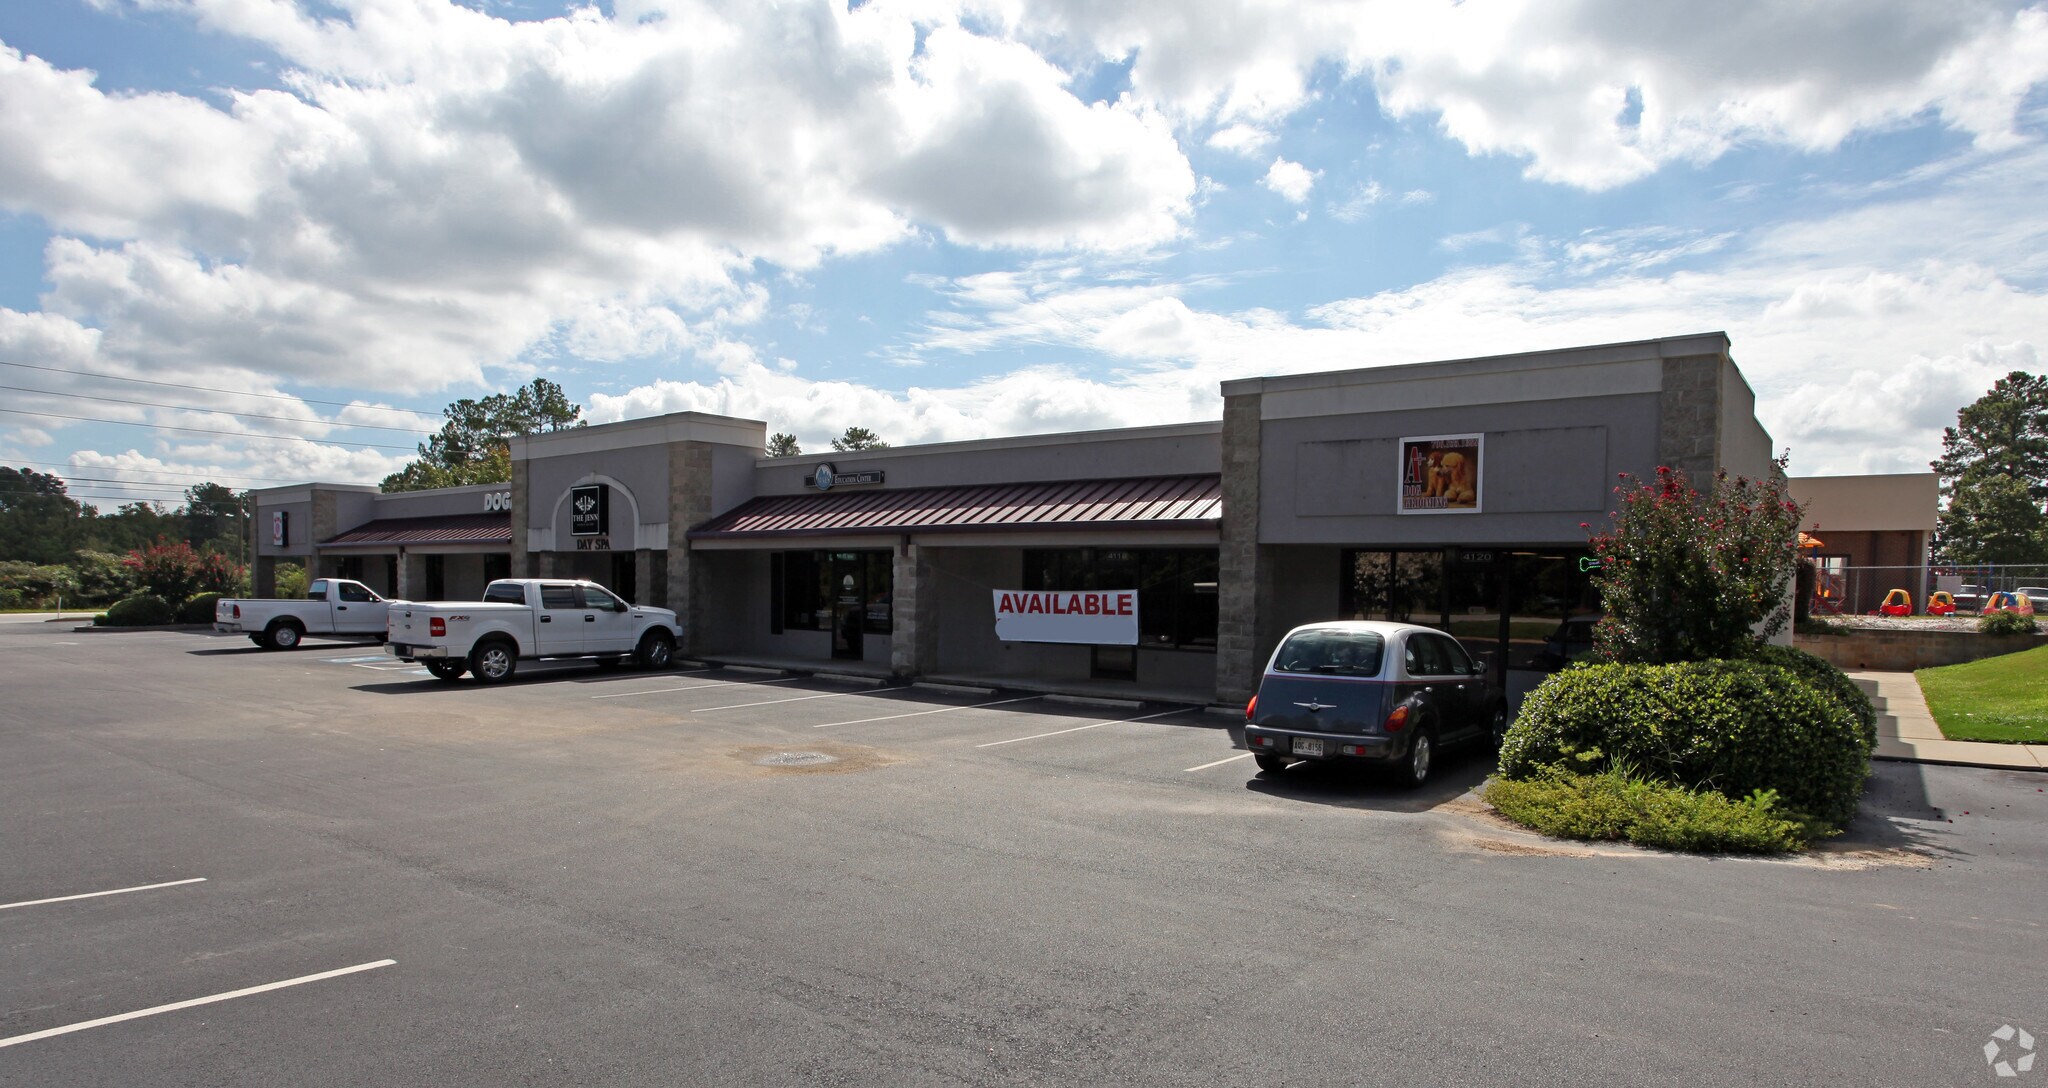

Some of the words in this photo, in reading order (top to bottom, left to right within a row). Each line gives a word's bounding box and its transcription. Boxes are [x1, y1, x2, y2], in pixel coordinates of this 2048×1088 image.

[856, 474, 871, 483] CENTER
[1403, 485, 1422, 497] DOG
[484, 491, 512, 511] DOG
[1404, 497, 1448, 509] GROOMING
[573, 514, 584, 522] THE
[584, 514, 599, 523] JENN
[577, 538, 592, 550] DAY
[595, 538, 611, 550] SPA
[1463, 553, 1492, 561] 4120
[998, 593, 1133, 615] AVAILABLE
